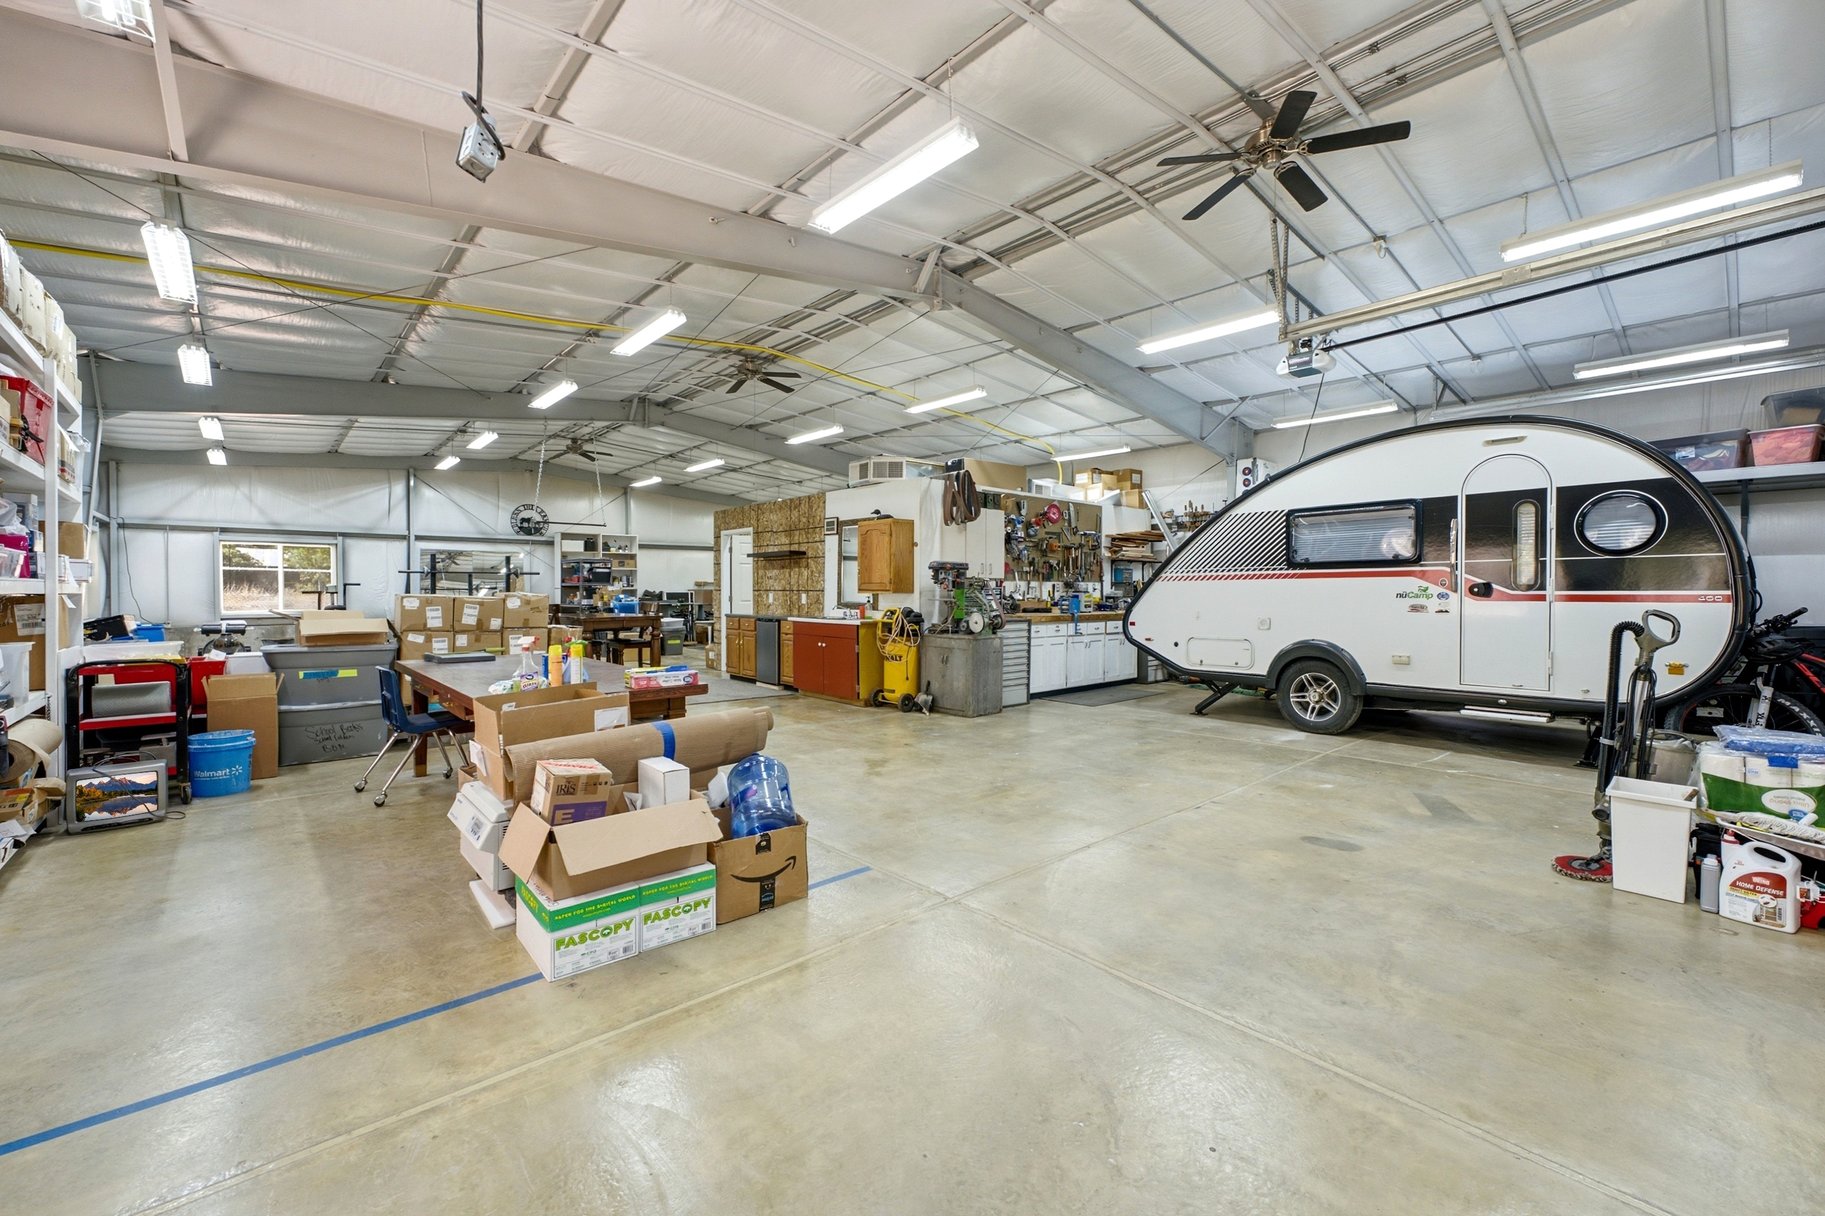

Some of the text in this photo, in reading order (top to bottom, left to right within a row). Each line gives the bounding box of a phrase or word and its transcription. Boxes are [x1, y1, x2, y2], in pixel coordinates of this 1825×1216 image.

[194, 768, 231, 778] Walmart
[1736, 880, 1755, 891] HOME
[1755, 885, 1785, 897] DEFENSE
[643, 897, 712, 926] FASCOPY
[555, 918, 634, 952] FASCOPY
